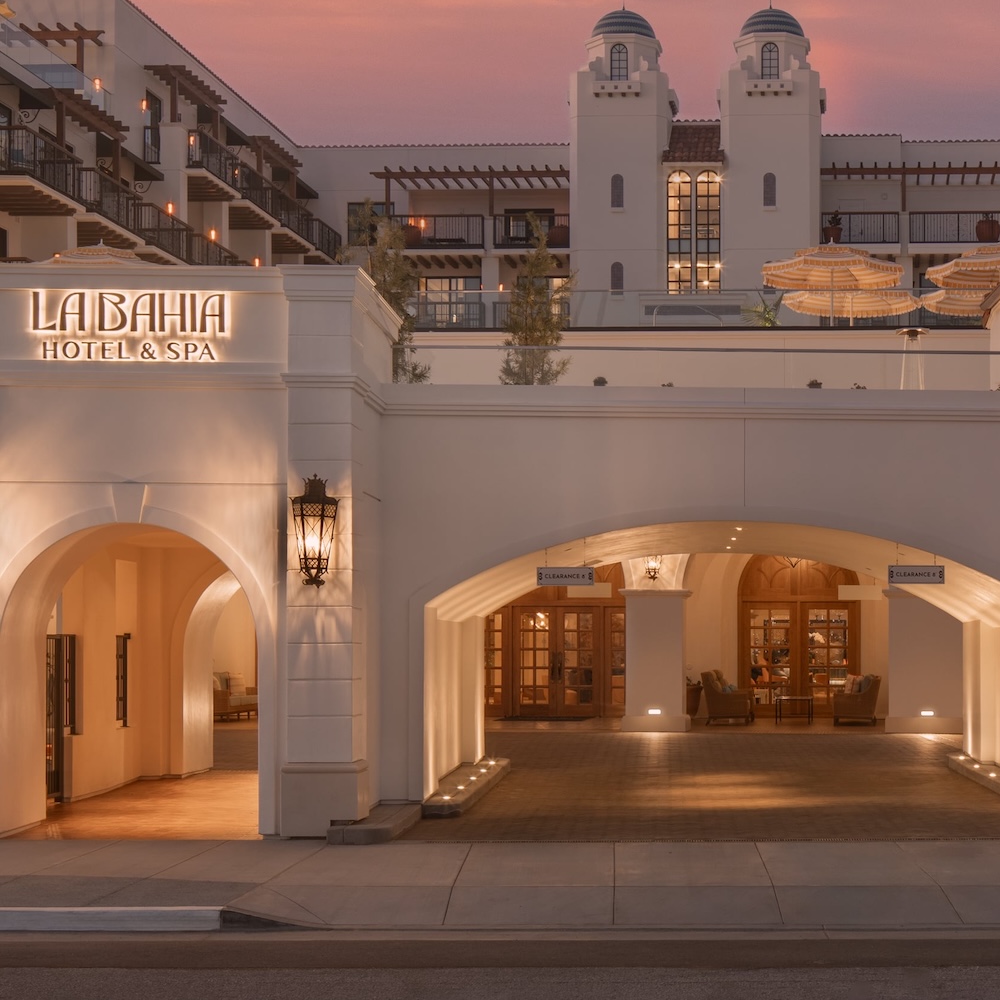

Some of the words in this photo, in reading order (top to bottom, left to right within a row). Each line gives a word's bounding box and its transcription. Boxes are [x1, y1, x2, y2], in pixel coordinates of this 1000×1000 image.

[32, 291, 86, 331] LA
[98, 292, 226, 333] BAHIA
[42, 341, 130, 360] HOTEL
[140, 342, 157, 360] &
[166, 342, 216, 361] SPA
